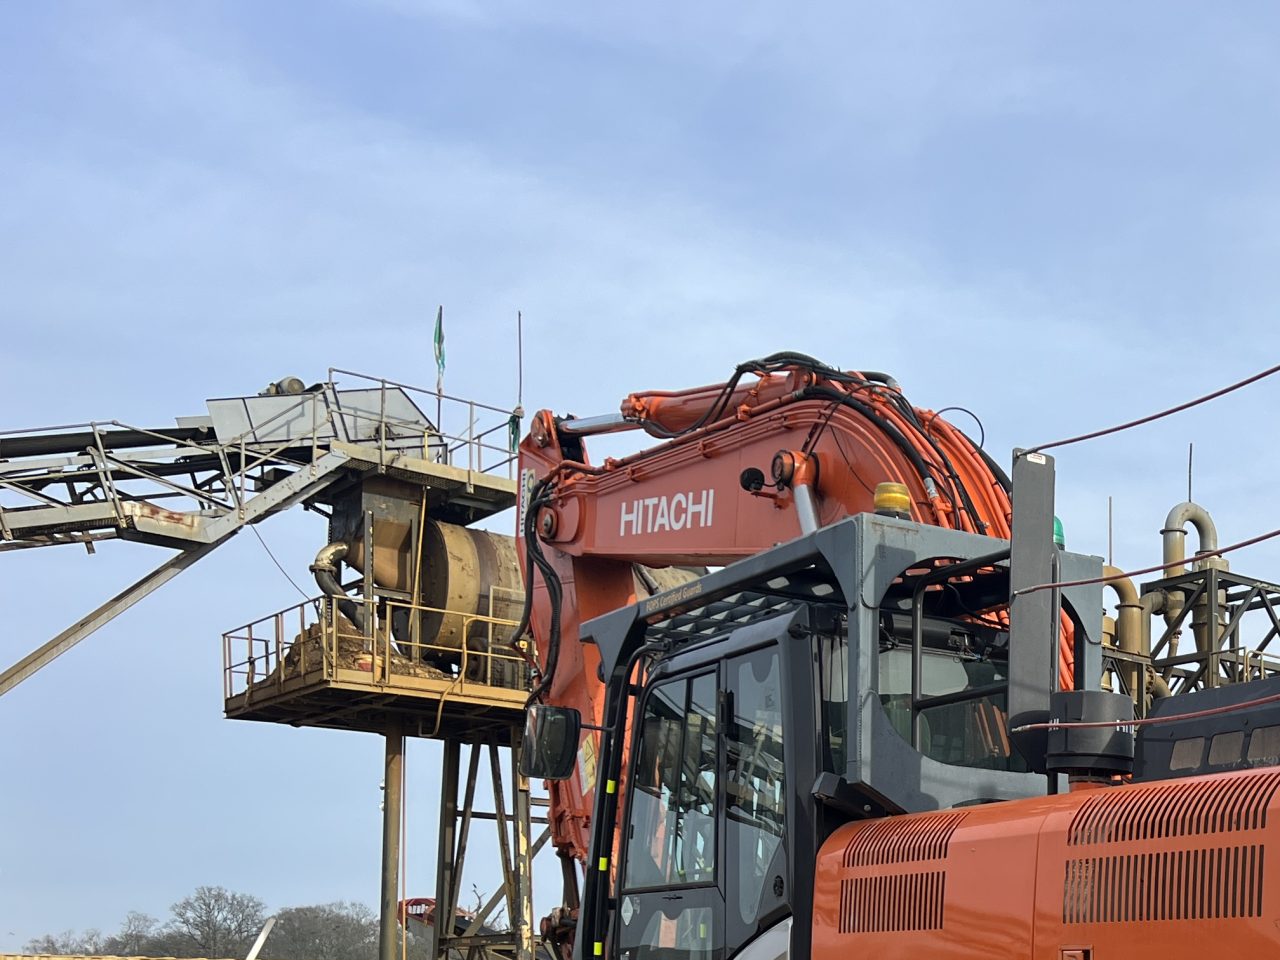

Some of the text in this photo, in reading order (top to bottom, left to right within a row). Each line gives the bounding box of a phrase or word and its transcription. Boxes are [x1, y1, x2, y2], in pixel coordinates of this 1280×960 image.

[620, 489, 714, 536] HITACHI
[646, 582, 702, 612] FOPS Certified Guards
